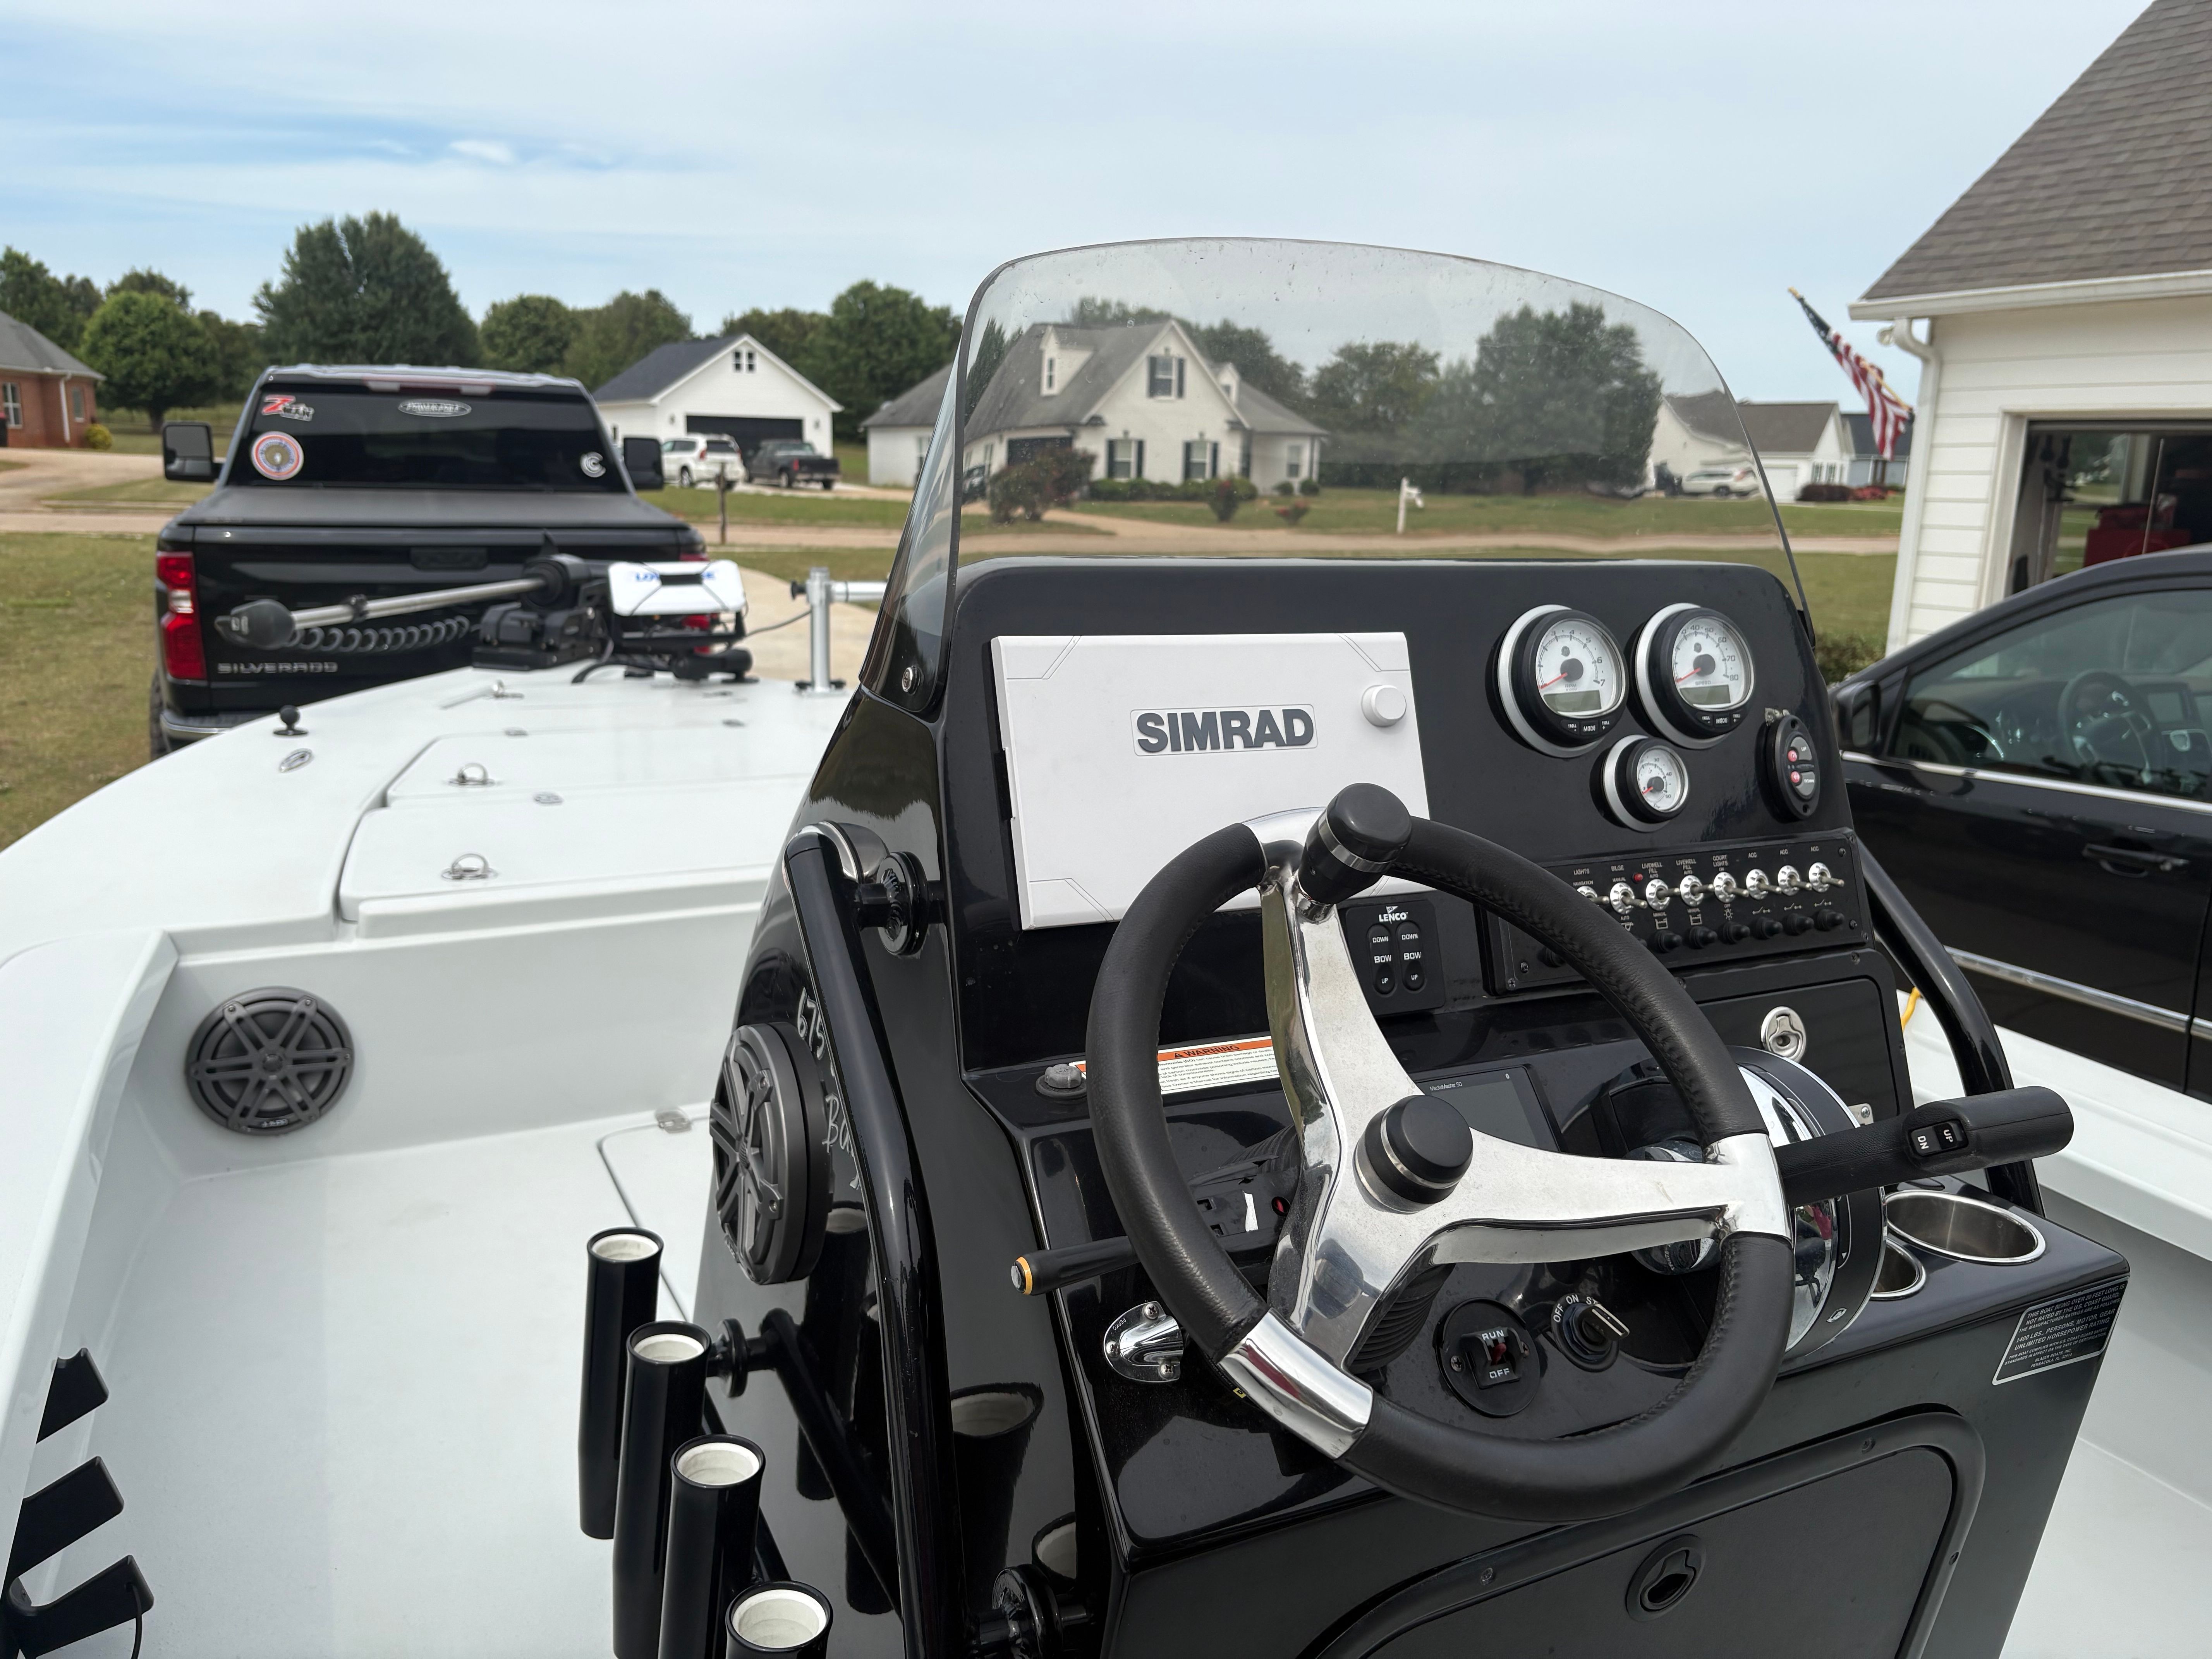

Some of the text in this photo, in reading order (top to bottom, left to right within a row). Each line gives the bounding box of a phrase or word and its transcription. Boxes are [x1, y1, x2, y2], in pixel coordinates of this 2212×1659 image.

[218, 662, 338, 673] SILVERADO
[1136, 708, 1313, 752] SIMRAD
[1379, 912, 1407, 922] LENCO
[1374, 955, 1391, 963] BOW
[1404, 951, 1421, 960] BOW
[1183, 1045, 1240, 1056] WARNING
[1429, 1083, 1456, 1091] MediaMaster
[1943, 1129, 1953, 1143] UP
[1917, 1135, 1929, 1150] DN
[2027, 1311, 2040, 1319] THIS
[2040, 1306, 2055, 1314] BOAT
[2054, 1301, 2070, 1310] BEING
[2071, 1296, 2085, 1305] OVER
[2092, 1290, 2106, 1298] FEET
[2105, 1285, 2119, 1294] LONG
[1553, 1303, 1563, 1322] OFF
[1566, 1294, 1579, 1305] ON
[2025, 1317, 2038, 1326] NOT
[2037, 1312, 2055, 1322] RATED
[2084, 1298, 2101, 1307] COAST
[1113, 1317, 1126, 1330] PERKO
[2028, 1314, 2064, 1330] MANUFACTURER
[2064, 1309, 2083, 1318] RATINGS
[2016, 1334, 2029, 1343] 1400
[2099, 1308, 2116, 1318] GEAR
[1482, 1330, 1504, 1341] RUN
[2014, 1317, 2110, 1351] UNLIMITED HORSEPOWER RATING
[2029, 1344, 2049, 1353] COMPLIES
[2004, 1355, 2028, 1365] STANDARDS
[2035, 1354, 2050, 1362] BLAZER
[1489, 1368, 1510, 1378] OFF
